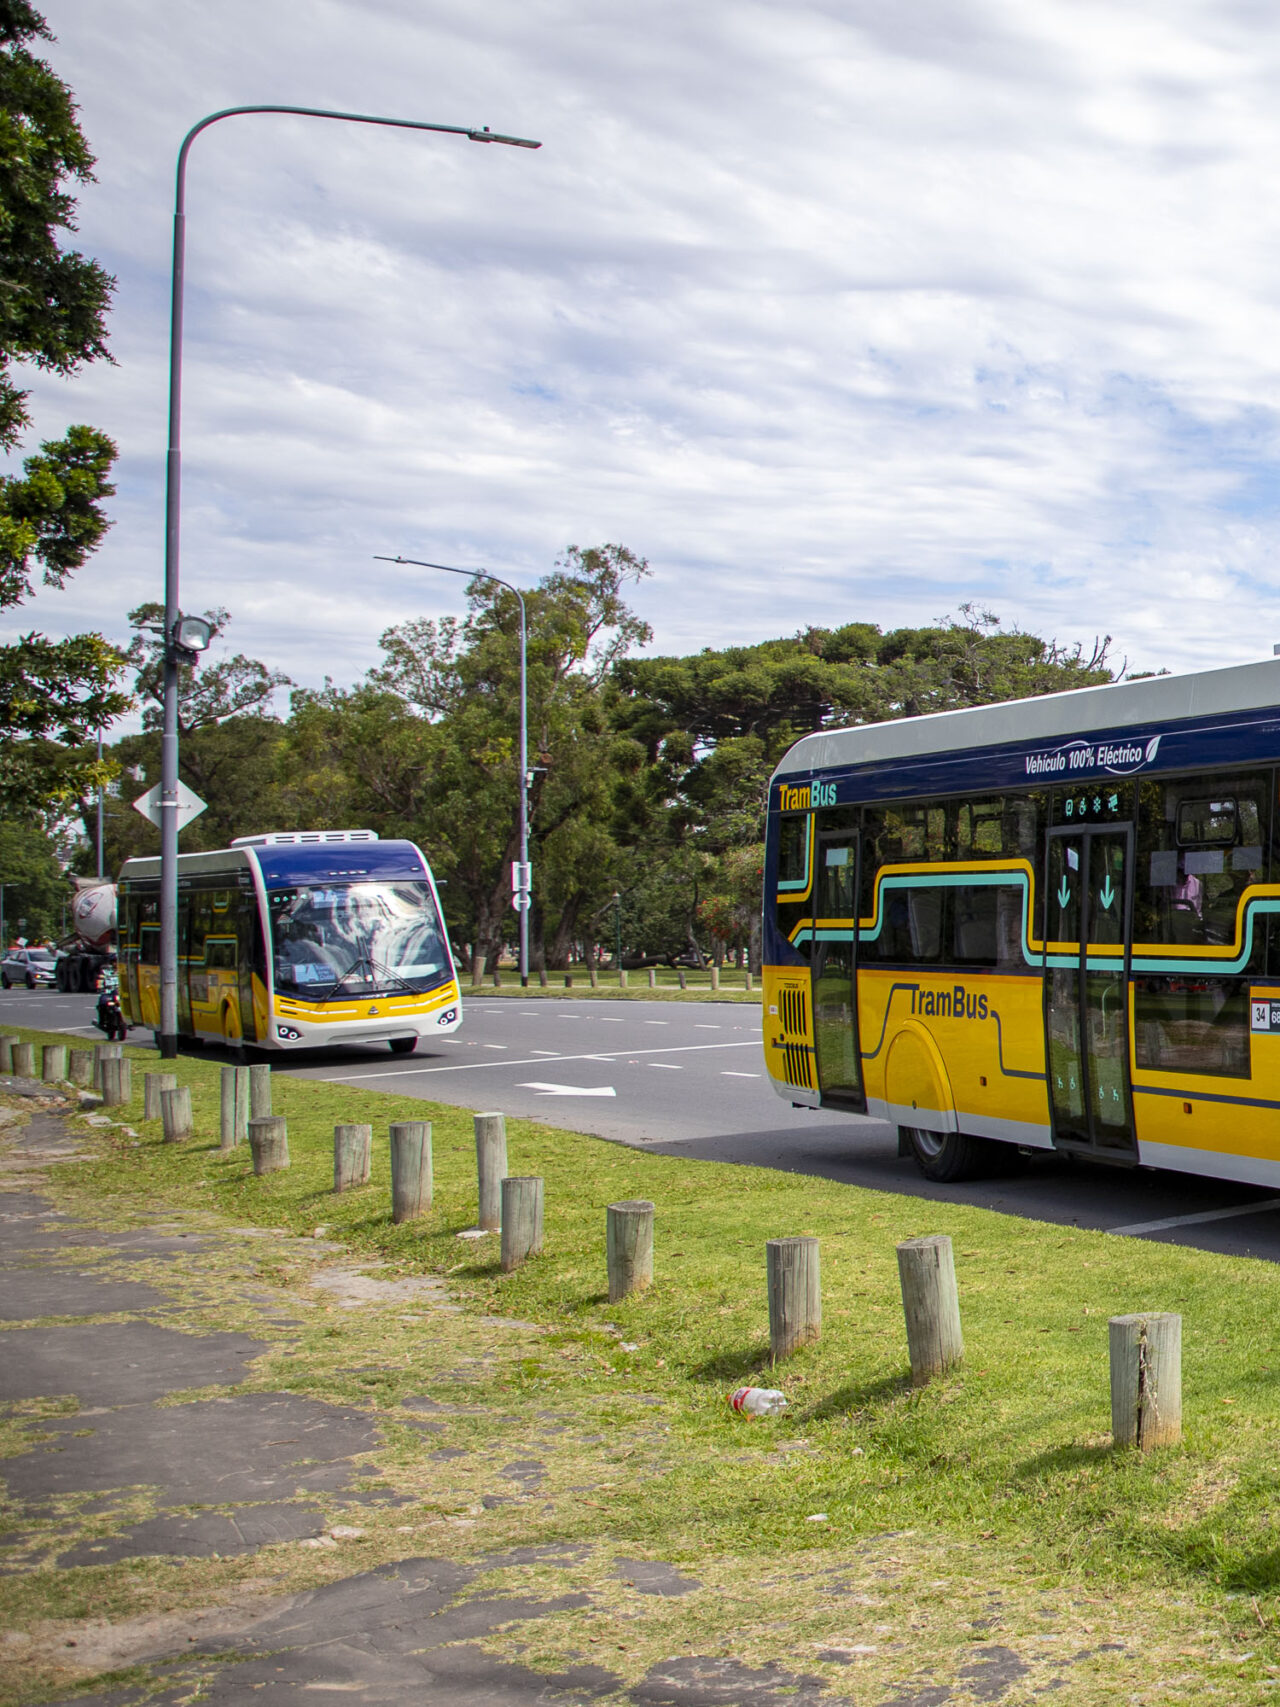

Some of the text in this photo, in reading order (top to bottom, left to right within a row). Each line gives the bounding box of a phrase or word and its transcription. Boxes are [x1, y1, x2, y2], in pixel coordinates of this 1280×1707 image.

[1025, 744, 1142, 774] Vehículo 100% Eléctrico
[779, 780, 837, 811] TramBus
[908, 984, 988, 1020] TramBus
[1255, 1007, 1266, 1022] 34
